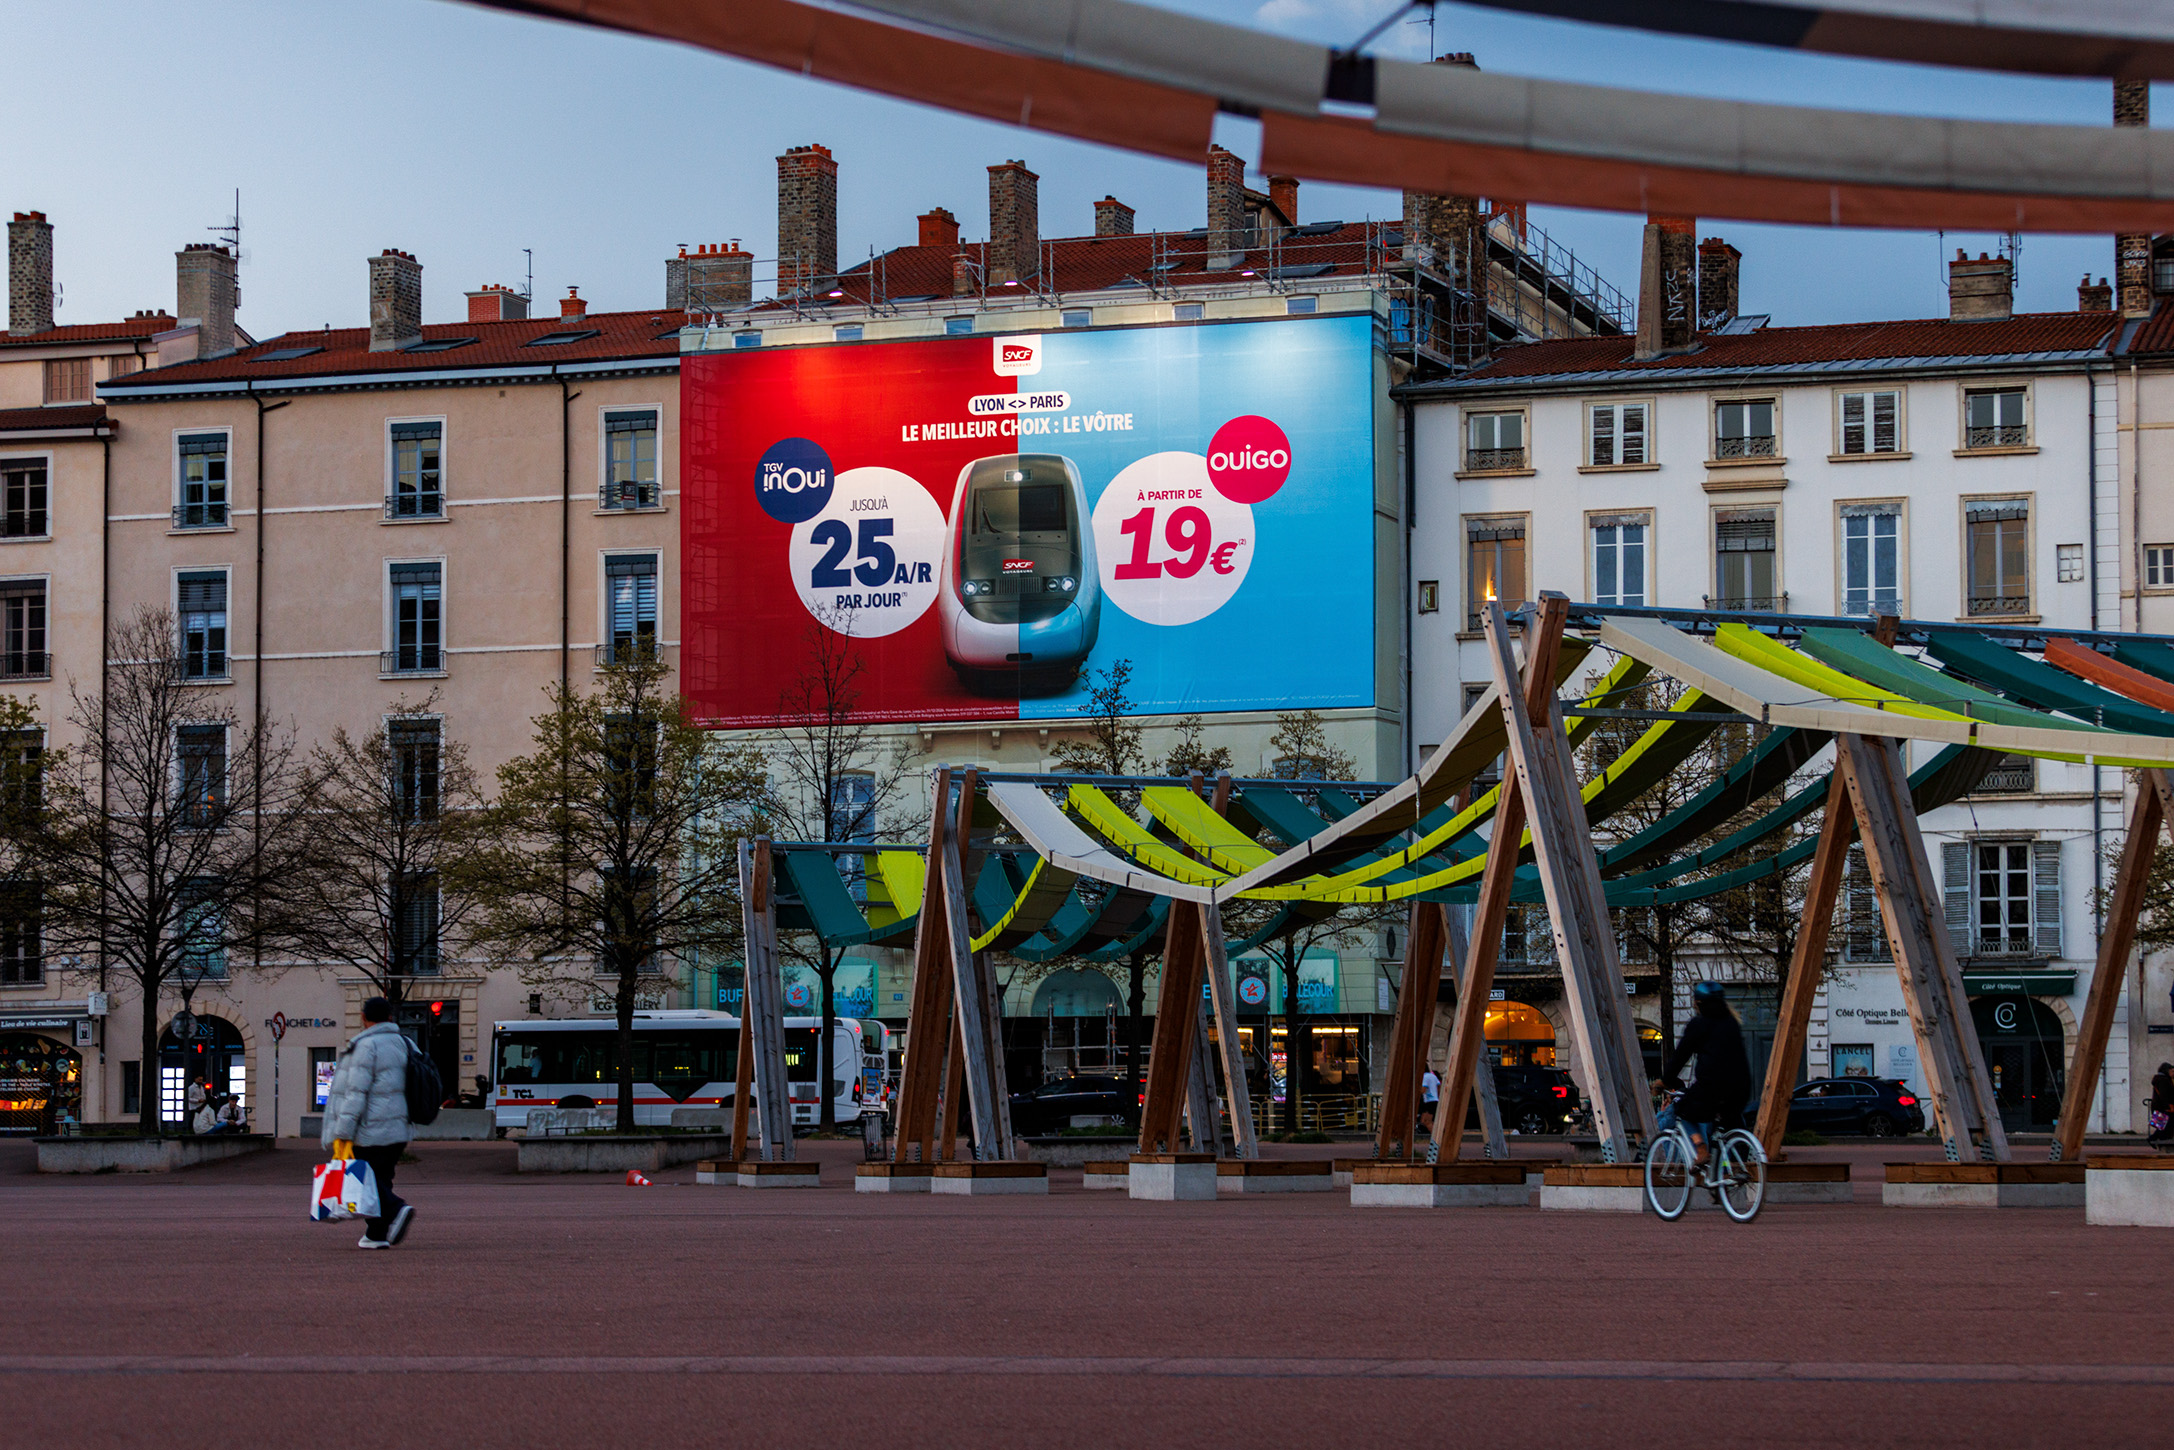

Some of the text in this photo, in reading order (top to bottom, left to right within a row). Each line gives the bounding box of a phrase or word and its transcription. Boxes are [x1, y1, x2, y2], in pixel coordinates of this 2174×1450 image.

[1003, 350, 1032, 360] SNCF
[974, 397, 1005, 412] LYON
[1030, 394, 1064, 409] PARIS
[901, 424, 919, 442] LE
[921, 420, 998, 441] MEILLEUR
[999, 417, 1051, 437] CHOIX
[1063, 415, 1081, 433] LE
[1082, 410, 1134, 432] VÔTRE
[763, 462, 784, 473] TGV
[1136, 488, 1203, 501] À PARTIR DE
[849, 495, 889, 512] JUSQU'À
[1003, 561, 1034, 570] SNCF
[836, 594, 862, 609] PAR
[1282, 983, 1334, 998] BLECOUR
[594, 1001, 612, 1011] ICG
[1835, 1008, 1855, 1017] Côté
[1856, 1008, 1888, 1018] Optique
[16, 1020, 25, 1028] de
[1836, 1047, 1871, 1055] LANCEL
